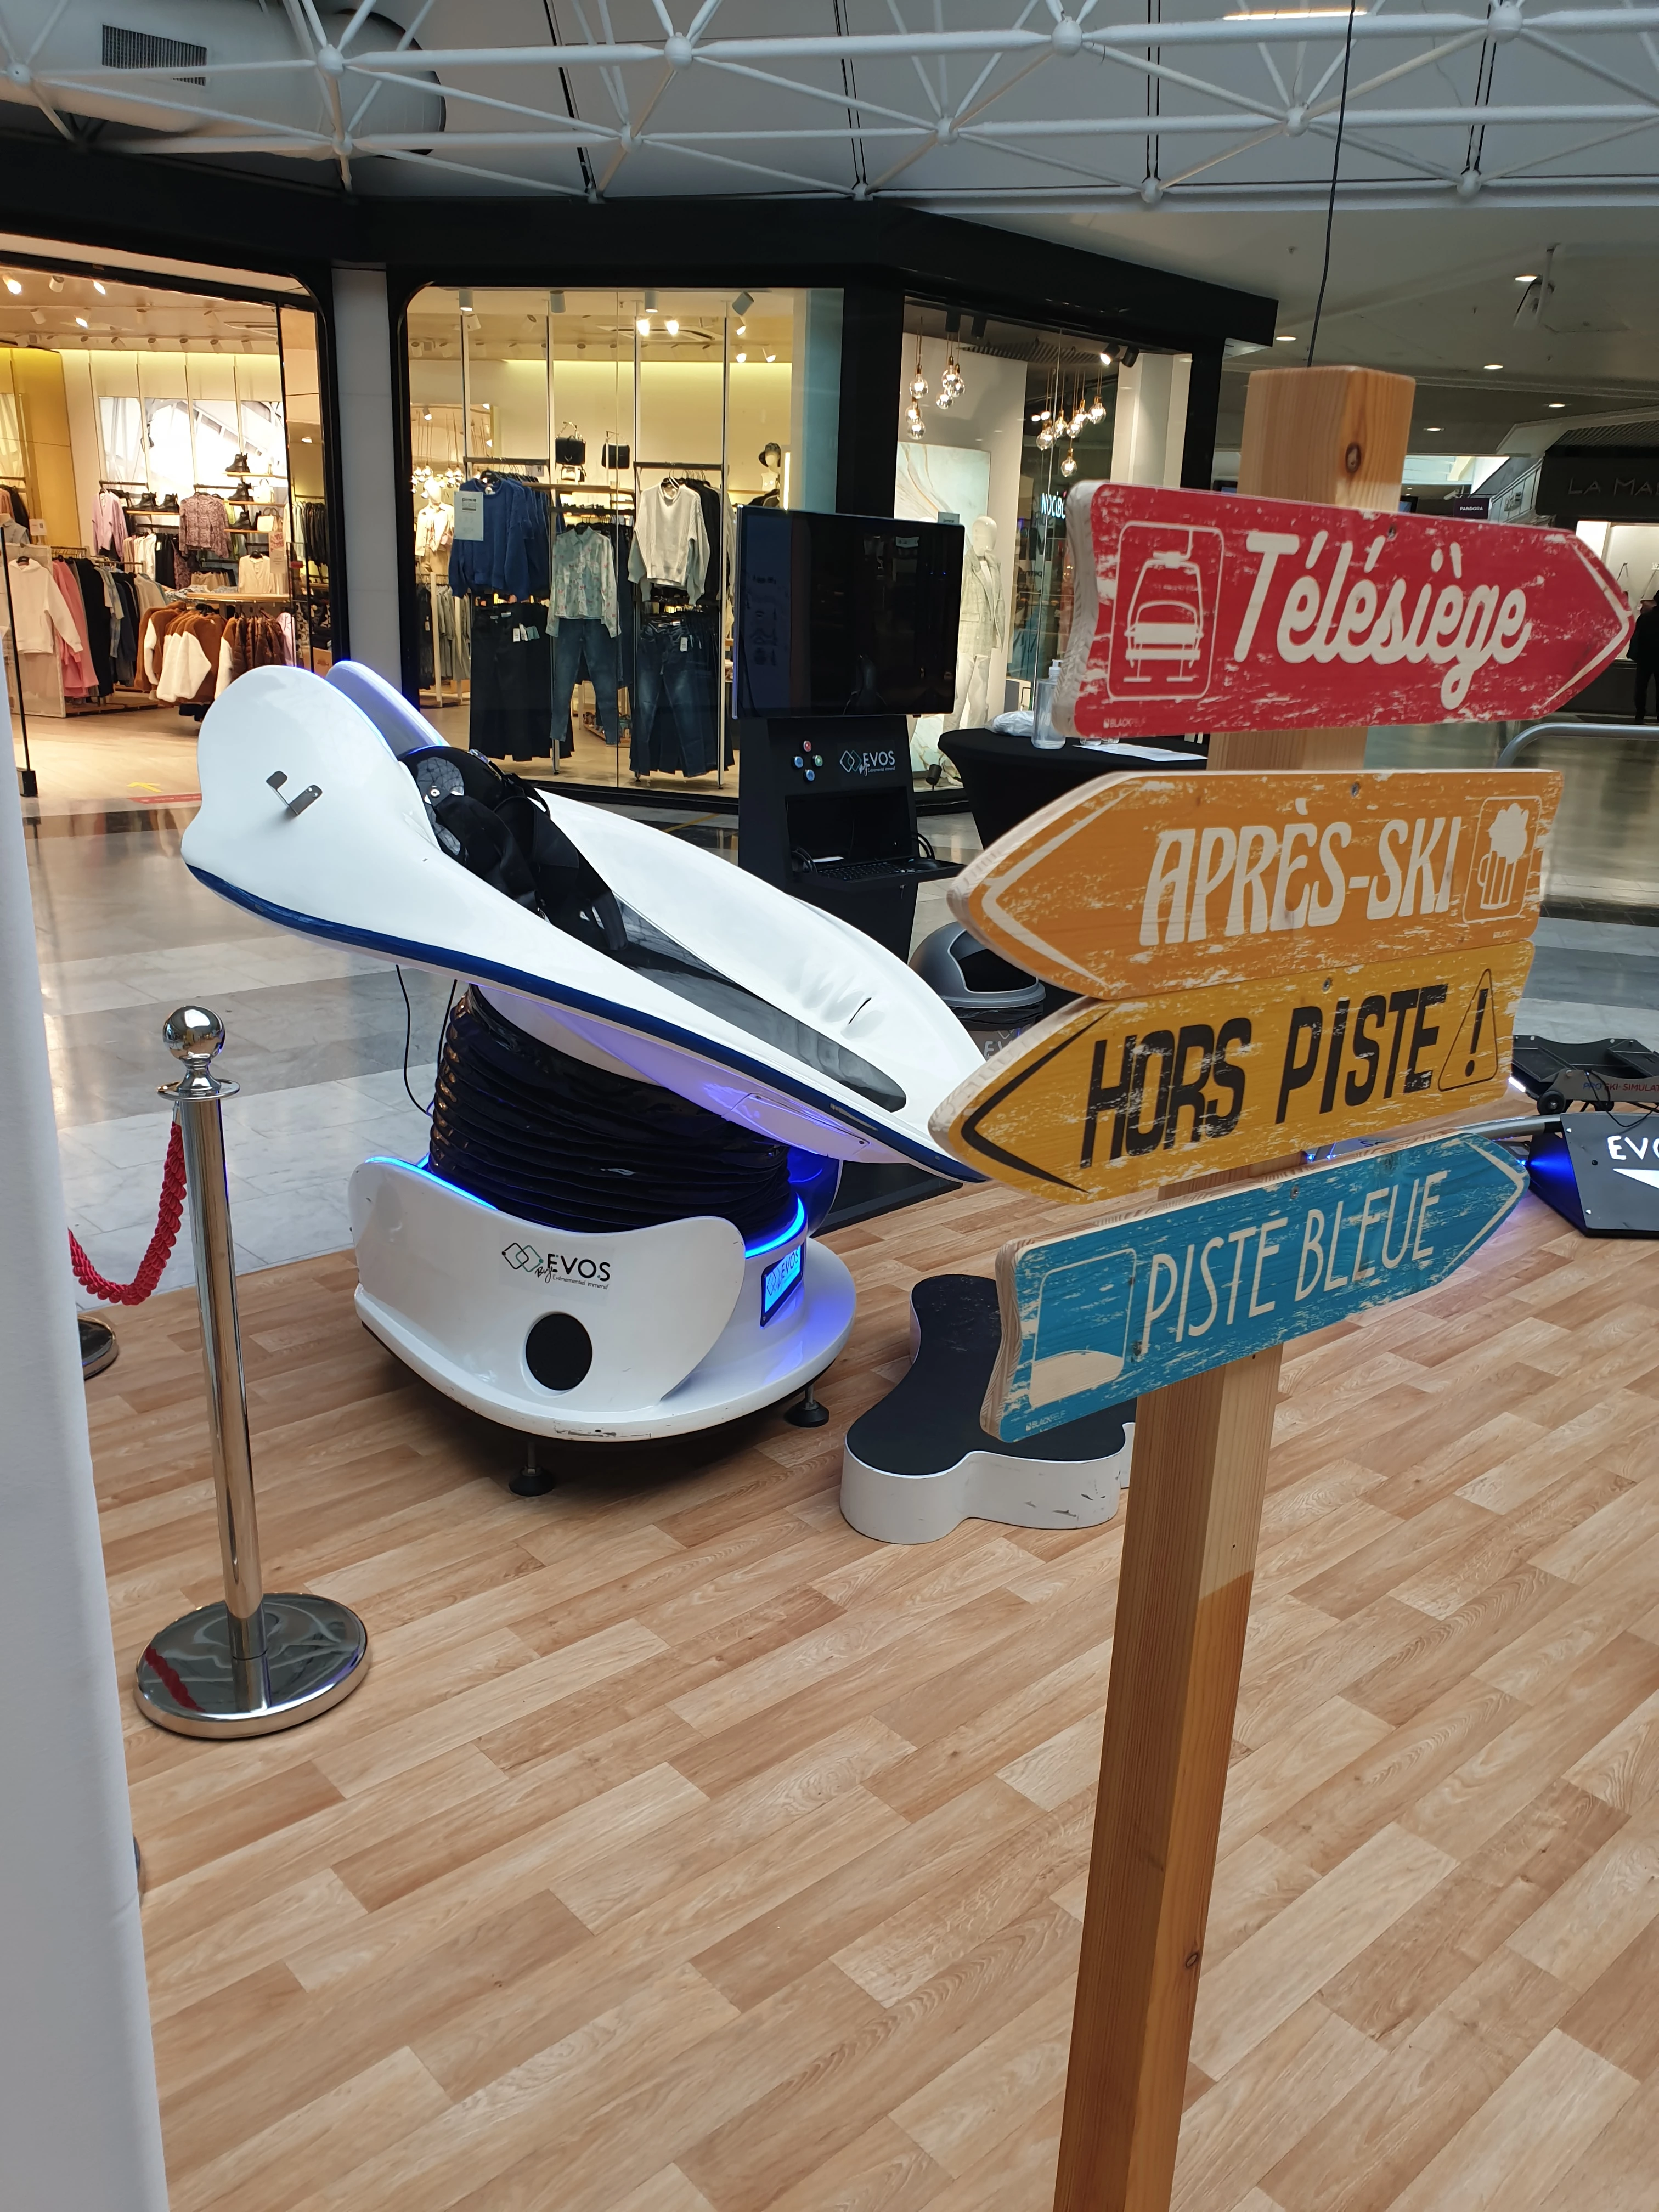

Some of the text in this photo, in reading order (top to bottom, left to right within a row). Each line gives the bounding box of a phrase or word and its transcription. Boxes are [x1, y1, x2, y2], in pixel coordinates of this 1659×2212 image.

[1568, 477, 1601, 495] LA
[1233, 529, 1533, 710] Télésiège
[862, 751, 895, 767] EVOS
[1138, 797, 1462, 947] APRÈS-SKI
[1079, 1017, 1253, 1170] HORS
[1275, 983, 1448, 1126] PISTE
[547, 1253, 611, 1282] EVOS
[781, 1250, 799, 1279] EVOS
[1141, 1170, 1448, 1356] PISTE BLEUE
